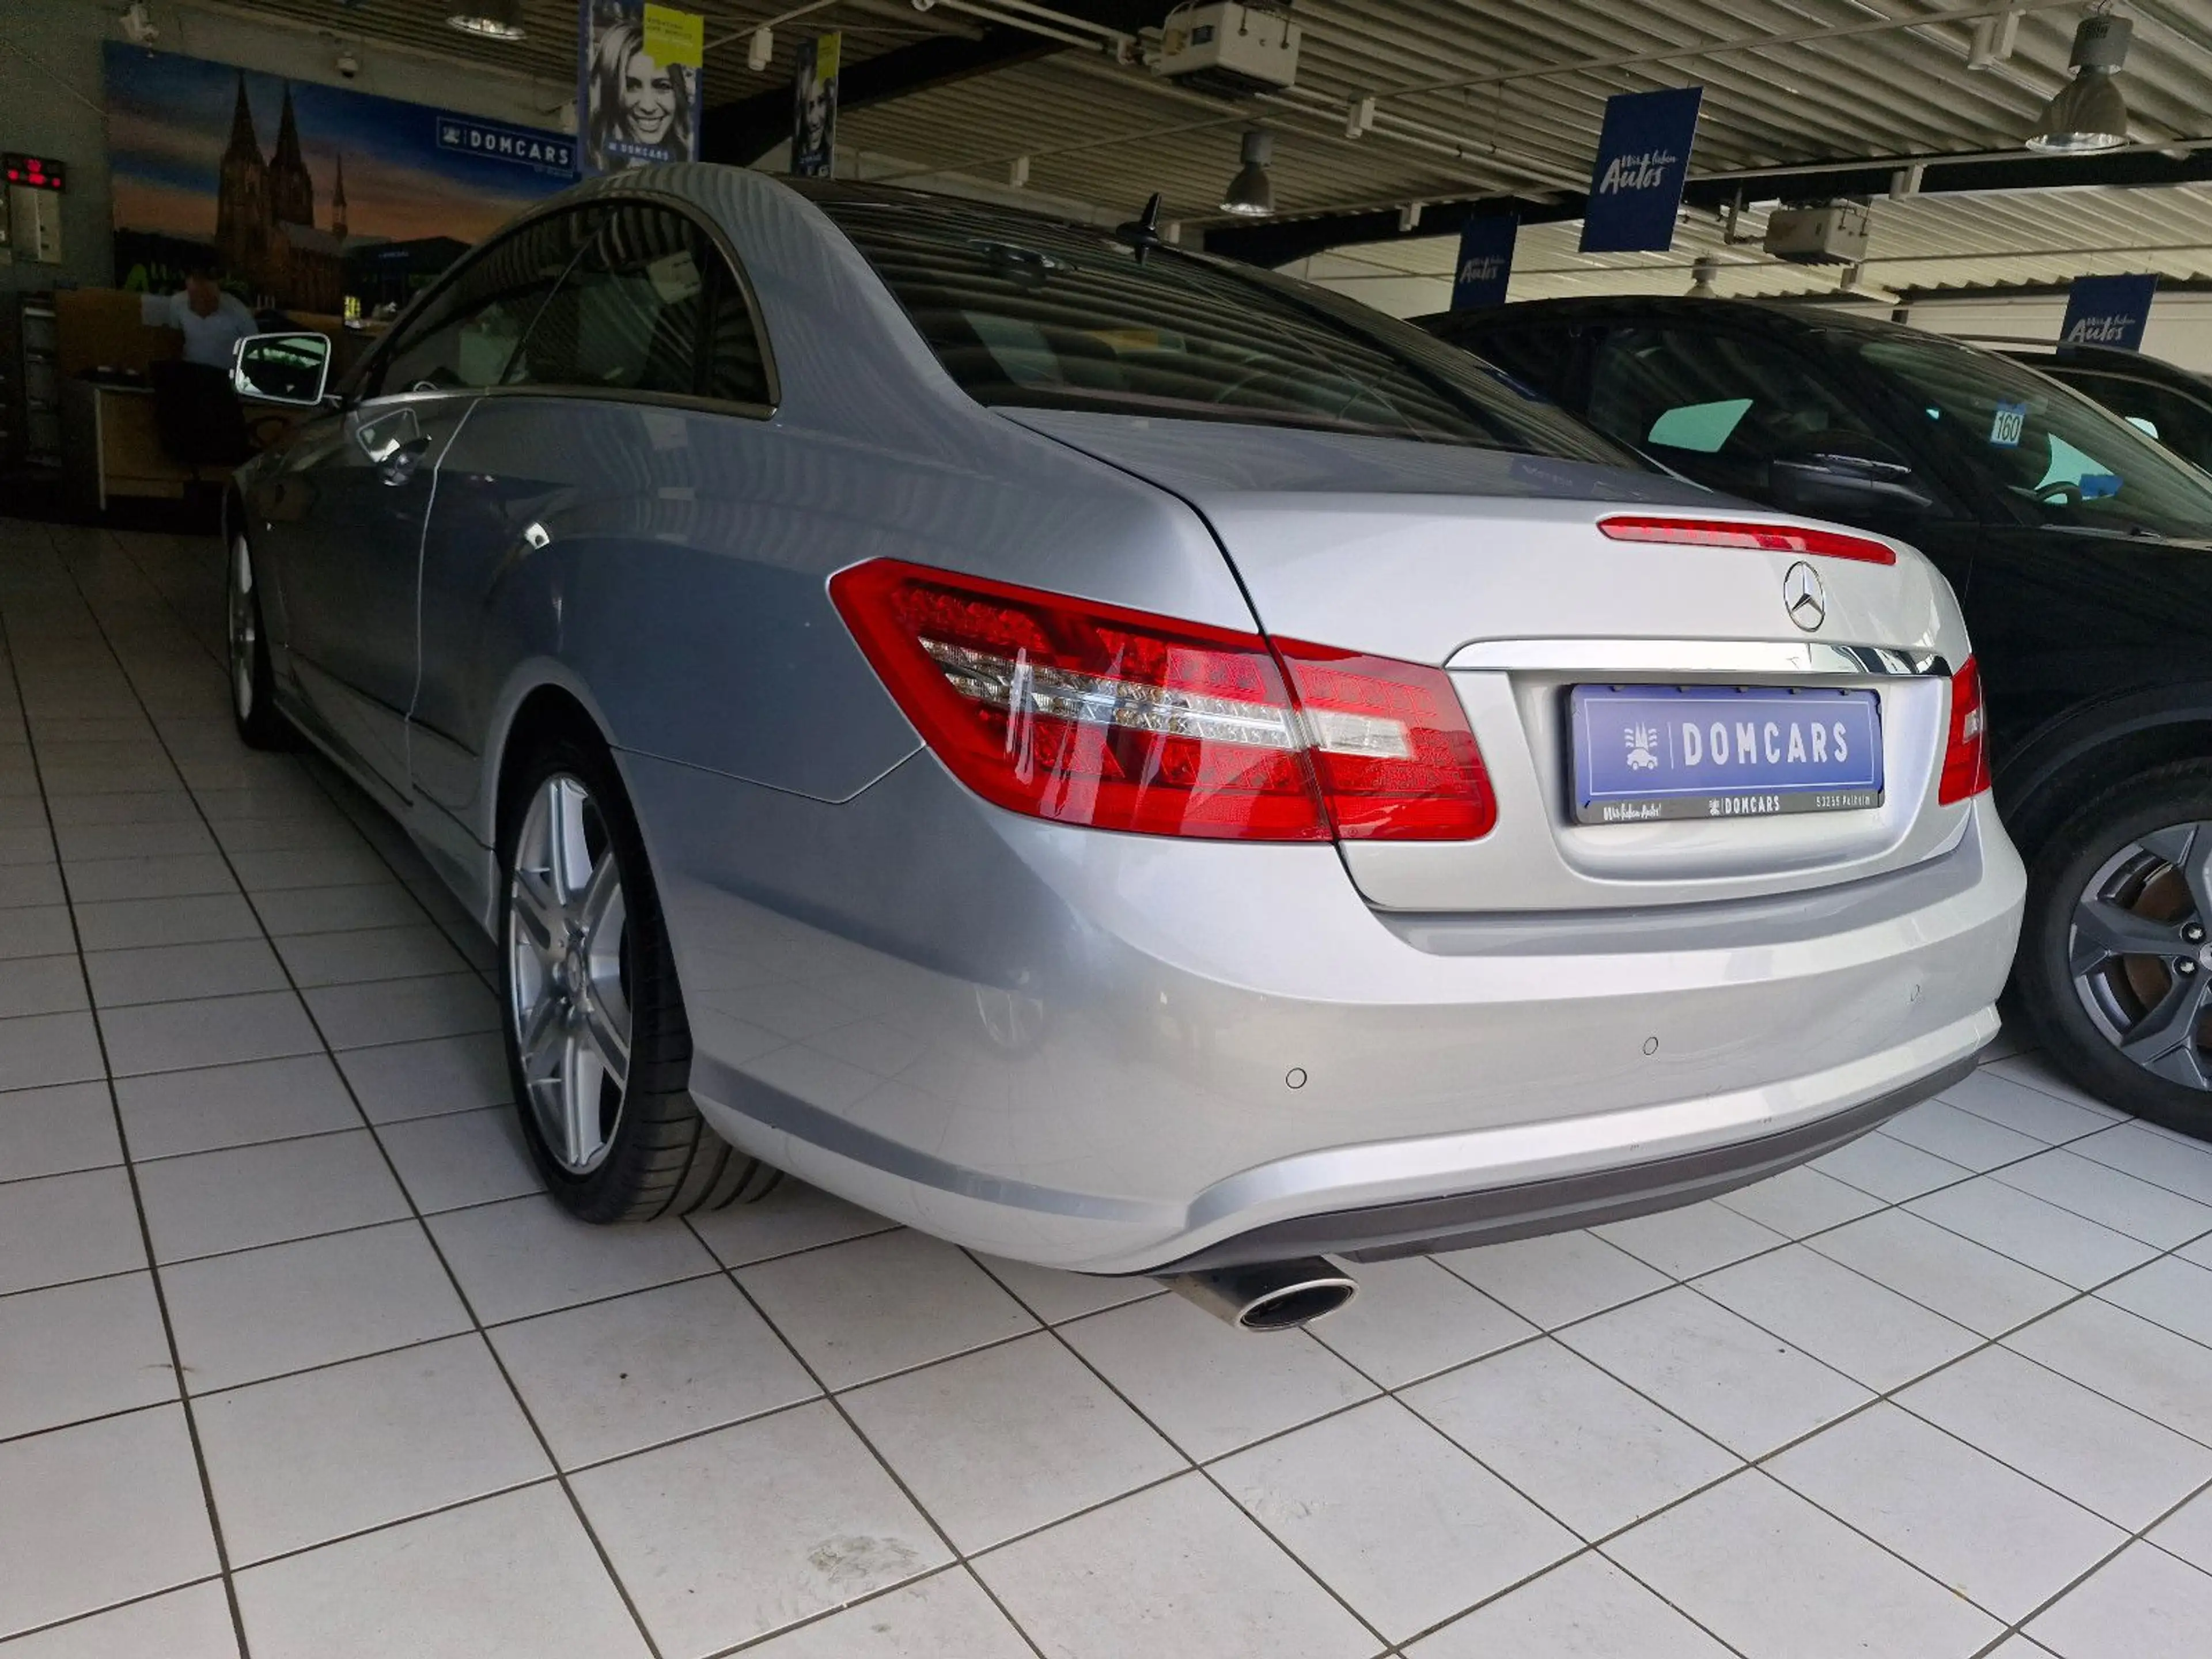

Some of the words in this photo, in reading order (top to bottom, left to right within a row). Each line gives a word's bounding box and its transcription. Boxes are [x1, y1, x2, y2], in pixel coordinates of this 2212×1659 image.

[470, 130, 568, 165] DOMCARS
[1599, 153, 1667, 195] Autos
[2068, 316, 2124, 344] Autos
[1997, 413, 2020, 442] 160
[1682, 722, 1848, 766] DOMCARS
[1725, 794, 1781, 814] DOMCARS
